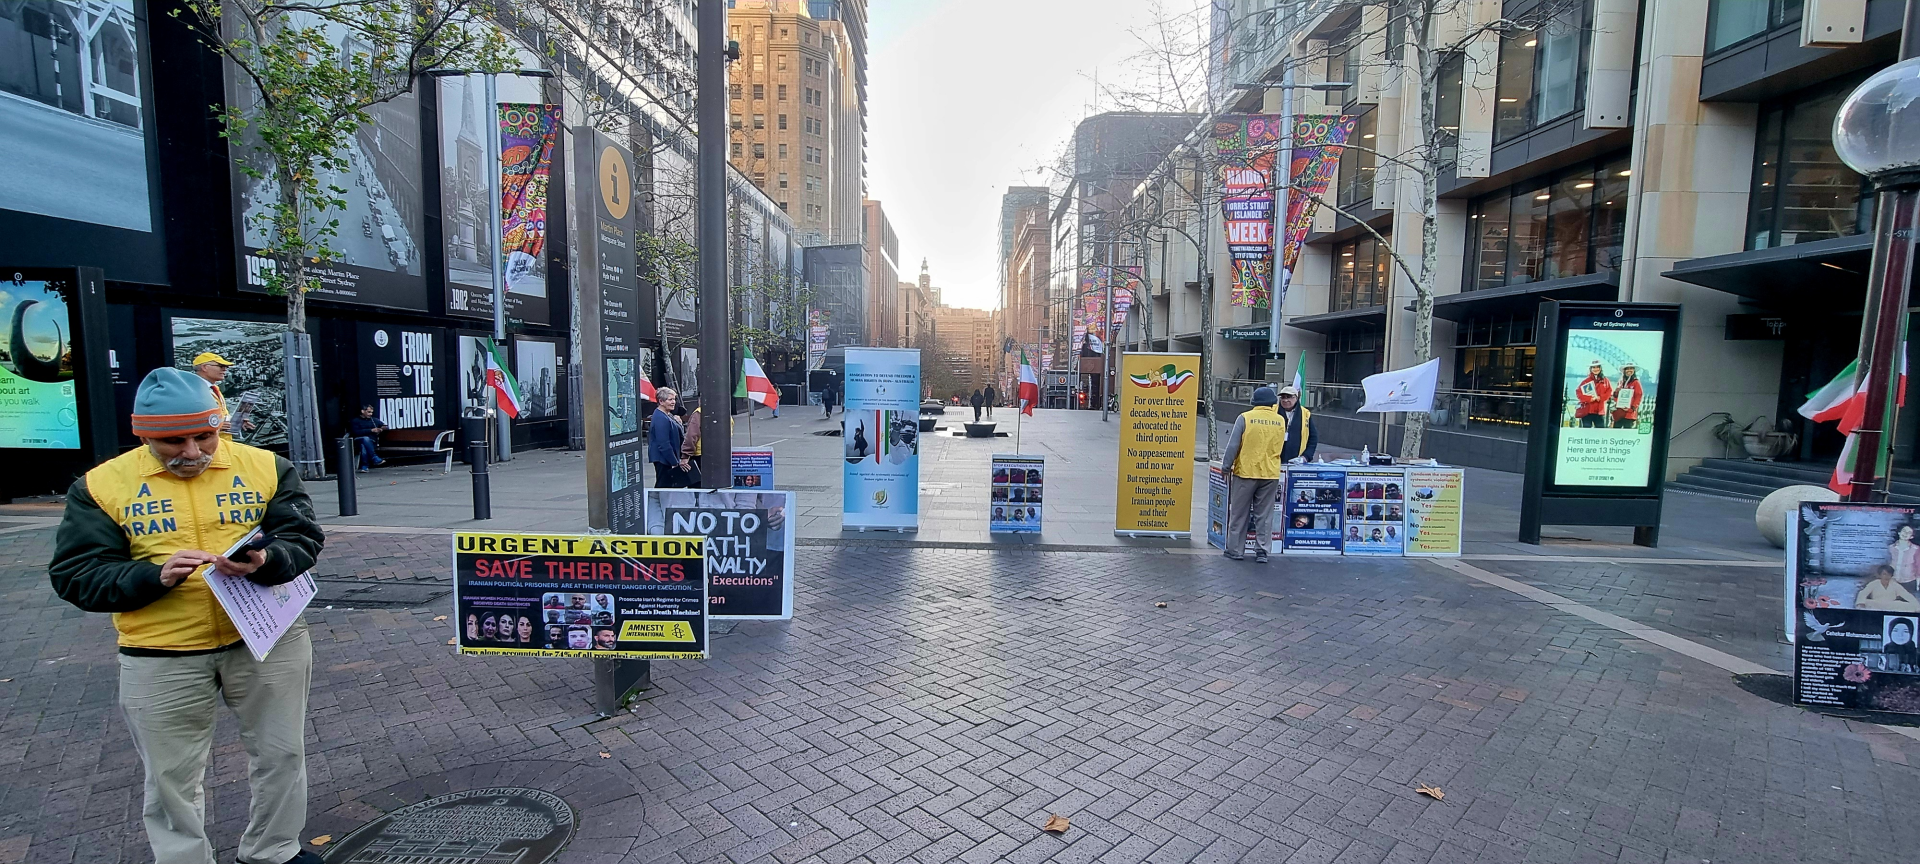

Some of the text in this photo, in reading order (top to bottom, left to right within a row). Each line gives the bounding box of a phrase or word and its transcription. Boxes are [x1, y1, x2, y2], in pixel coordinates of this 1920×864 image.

[1226, 170, 1268, 185] NAIDOC
[1227, 201, 1270, 211] TORRES STRAIT
[1234, 211, 1262, 219] ISLANDER
[600, 221, 616, 234] Martin
[1228, 222, 1267, 242] WEEK
[401, 331, 433, 363] FROM
[413, 364, 434, 395] THE
[18, 387, 30, 395] art
[4, 397, 40, 407] you walk
[1134, 396, 1146, 405] For
[1165, 396, 1185, 406] three
[379, 396, 435, 430] ARCHIVES
[1129, 408, 1188, 419] decades, we have
[1132, 420, 1182, 430] advocated the
[1136, 432, 1178, 445] third option
[1567, 437, 1583, 445] First
[1584, 437, 1600, 445] time
[1609, 438, 1641, 447] Sydney?
[1127, 447, 1185, 459] No appeasement
[1567, 446, 1584, 454] Here
[1609, 447, 1631, 456] things
[1135, 460, 1149, 469] and
[1150, 462, 1160, 470] no
[232, 475, 246, 489] A
[1127, 474, 1183, 486] But regime change
[137, 482, 152, 498] A
[1135, 485, 1172, 497] through the
[1131, 497, 1176, 508] Iranian people
[1139, 508, 1168, 517] and their
[672, 511, 761, 535] NO TO
[1137, 518, 1169, 528] resistance
[457, 536, 704, 556] URGENT ACTION
[706, 535, 751, 557] ATH
[475, 558, 685, 582] SAVE THEIR LIVES
[708, 555, 767, 575] NALTY
[494, 580, 524, 588] POLITICAL
[628, 624, 665, 632] AMNESTY
[393, 789, 469, 819] MARTIN
[470, 787, 522, 798] PLACE
